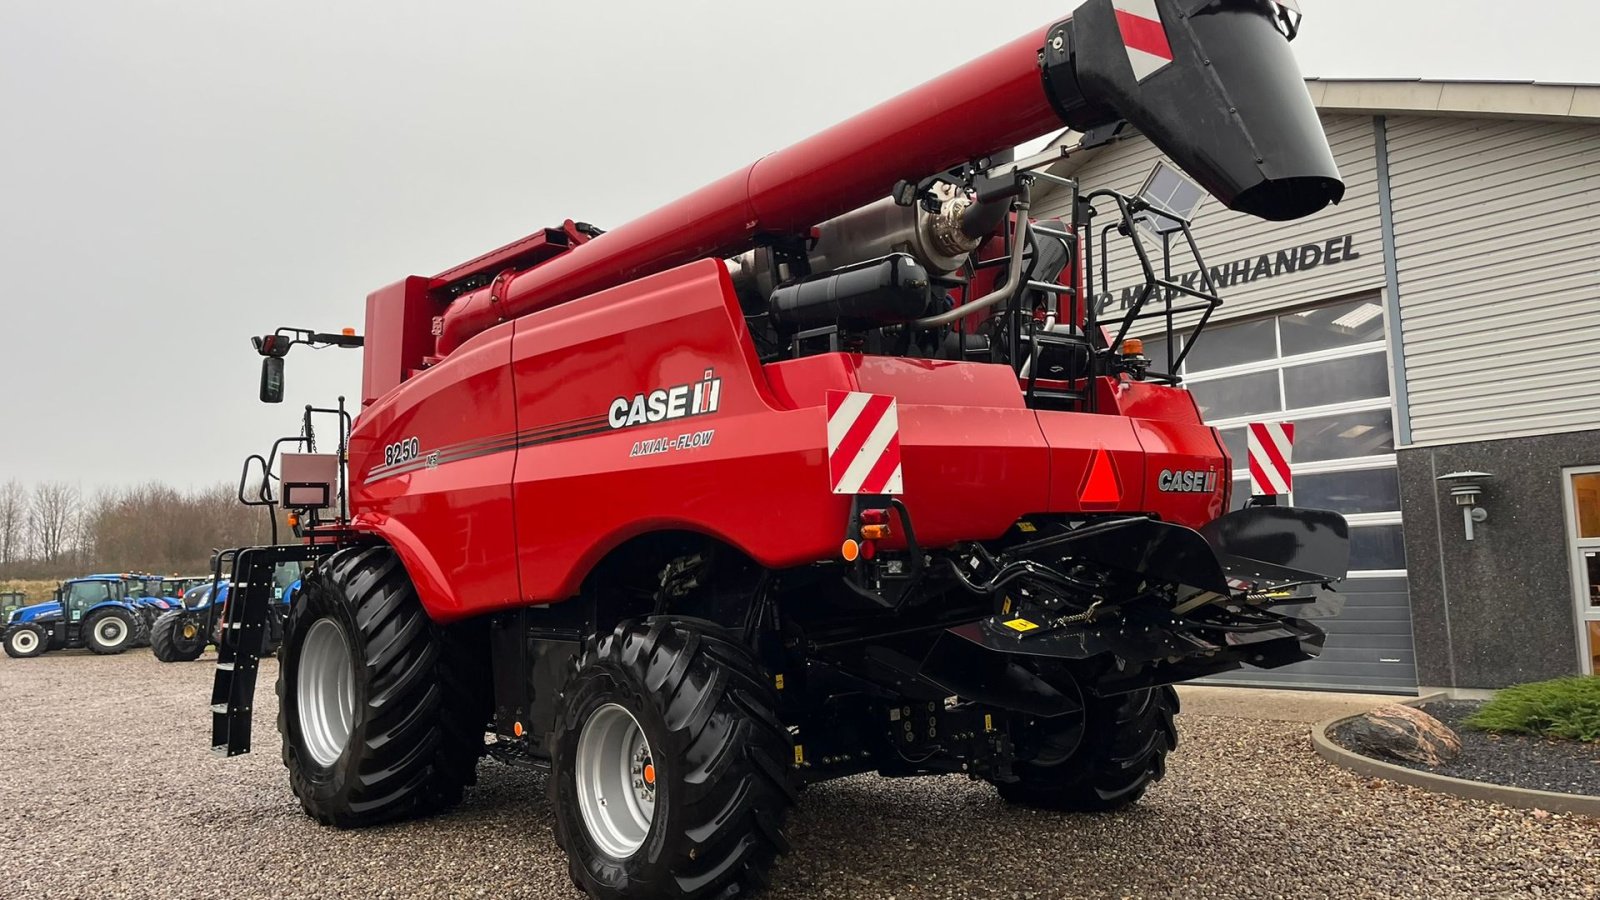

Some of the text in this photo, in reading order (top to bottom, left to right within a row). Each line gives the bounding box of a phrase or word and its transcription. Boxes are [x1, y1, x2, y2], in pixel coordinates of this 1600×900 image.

[608, 385, 689, 429] CASE
[385, 437, 419, 466] 8250
[629, 430, 715, 457] AXIAL-FLOW
[1158, 469, 1203, 492] CASE
